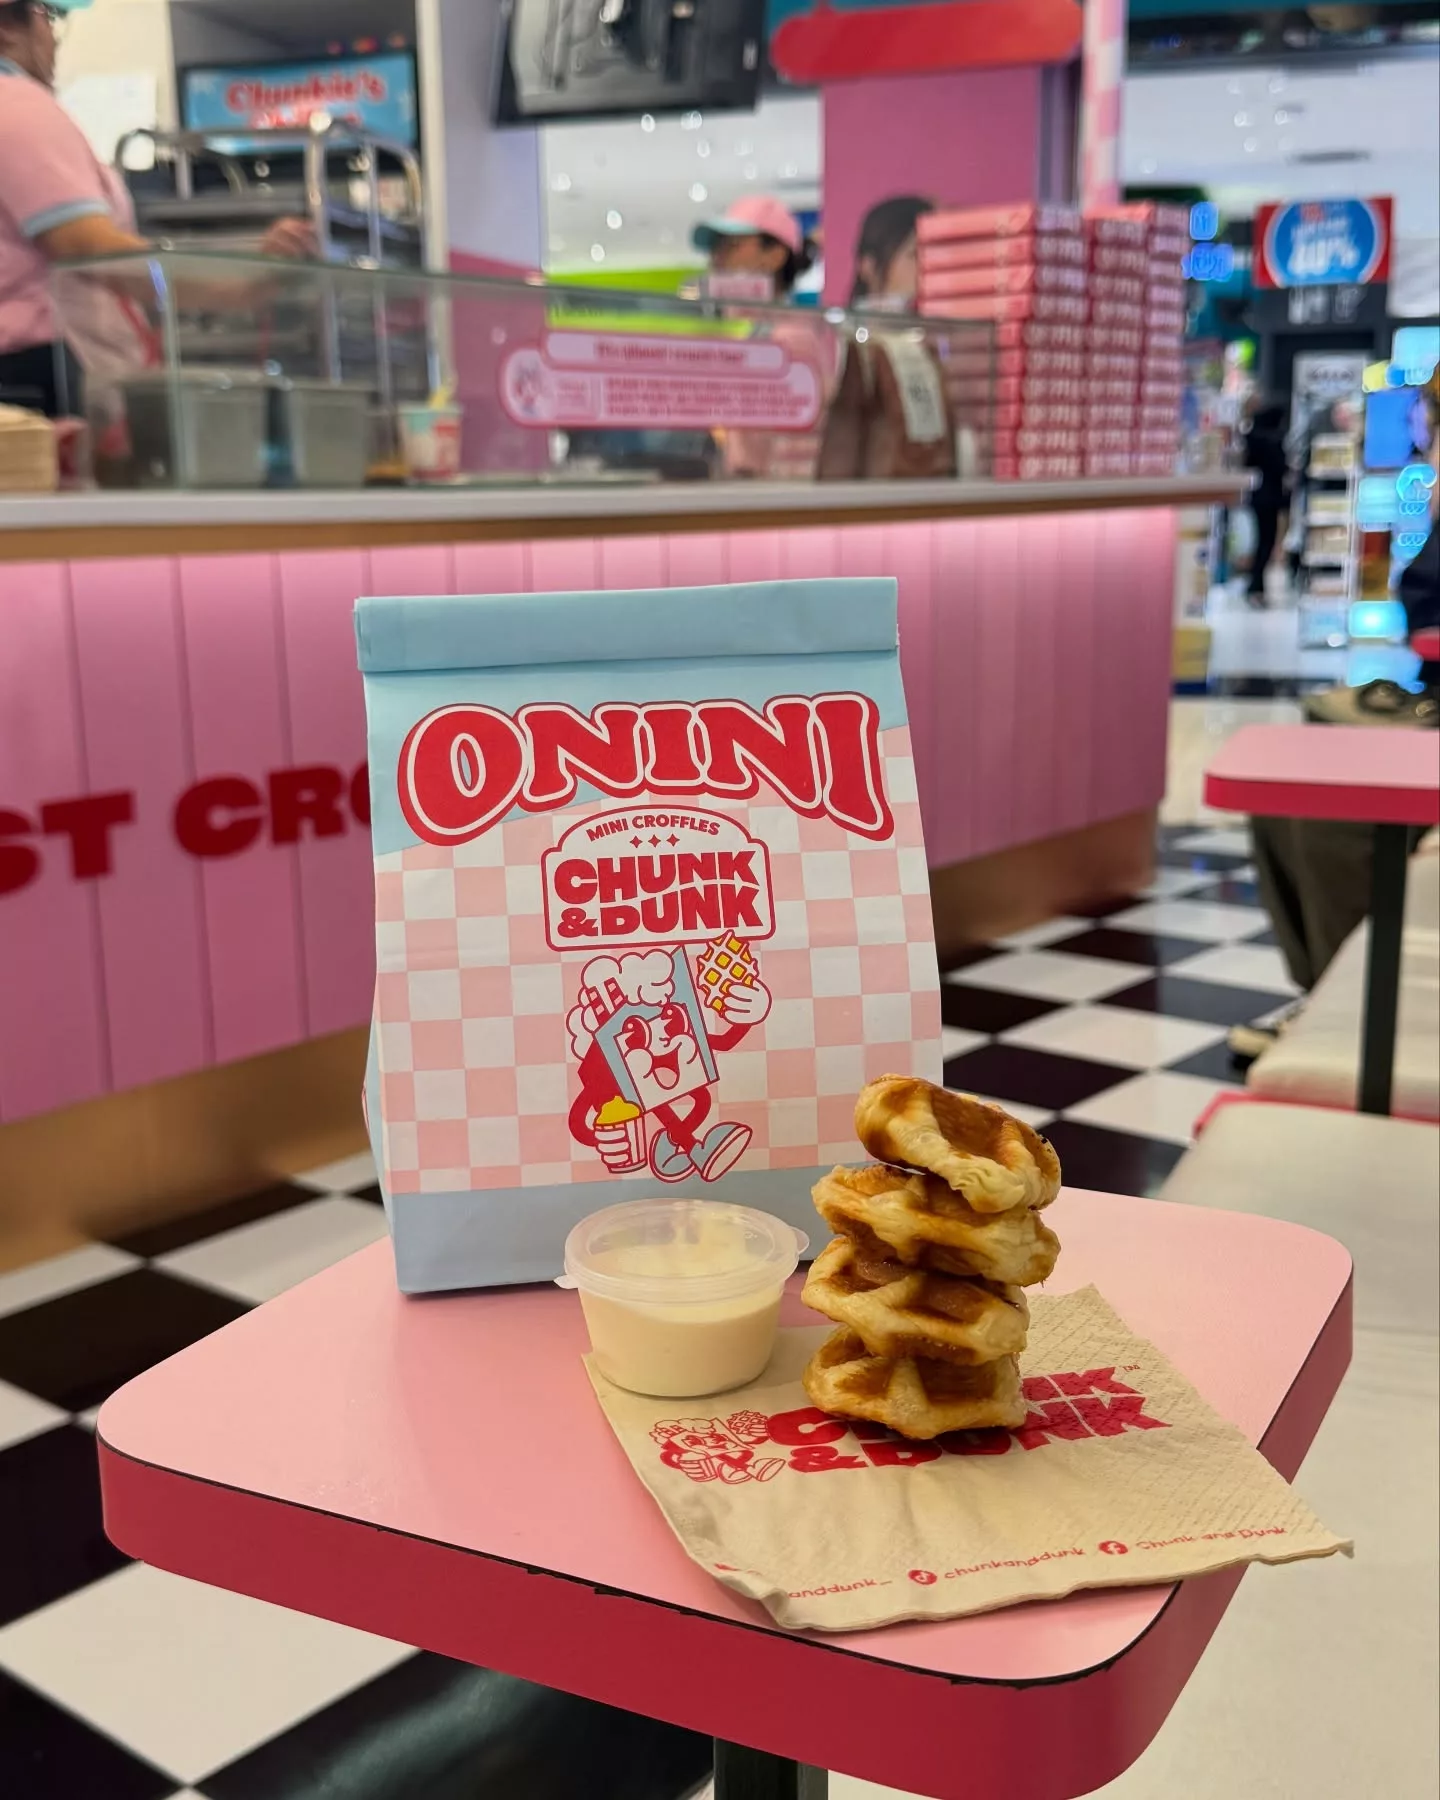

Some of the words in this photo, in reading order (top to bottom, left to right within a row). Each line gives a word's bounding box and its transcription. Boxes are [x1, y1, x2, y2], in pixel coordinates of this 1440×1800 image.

[398, 691, 894, 847] ONINI
[174, 761, 371, 860] CR
[586, 818, 629, 842] MINI
[632, 814, 721, 836] CROFFLES
[554, 850, 760, 905] CHUNK
[944, 1547, 1085, 1579] chunkanddunk
[1136, 1535, 1196, 1550] Chunk
[1237, 1526, 1287, 1539] Dunk
